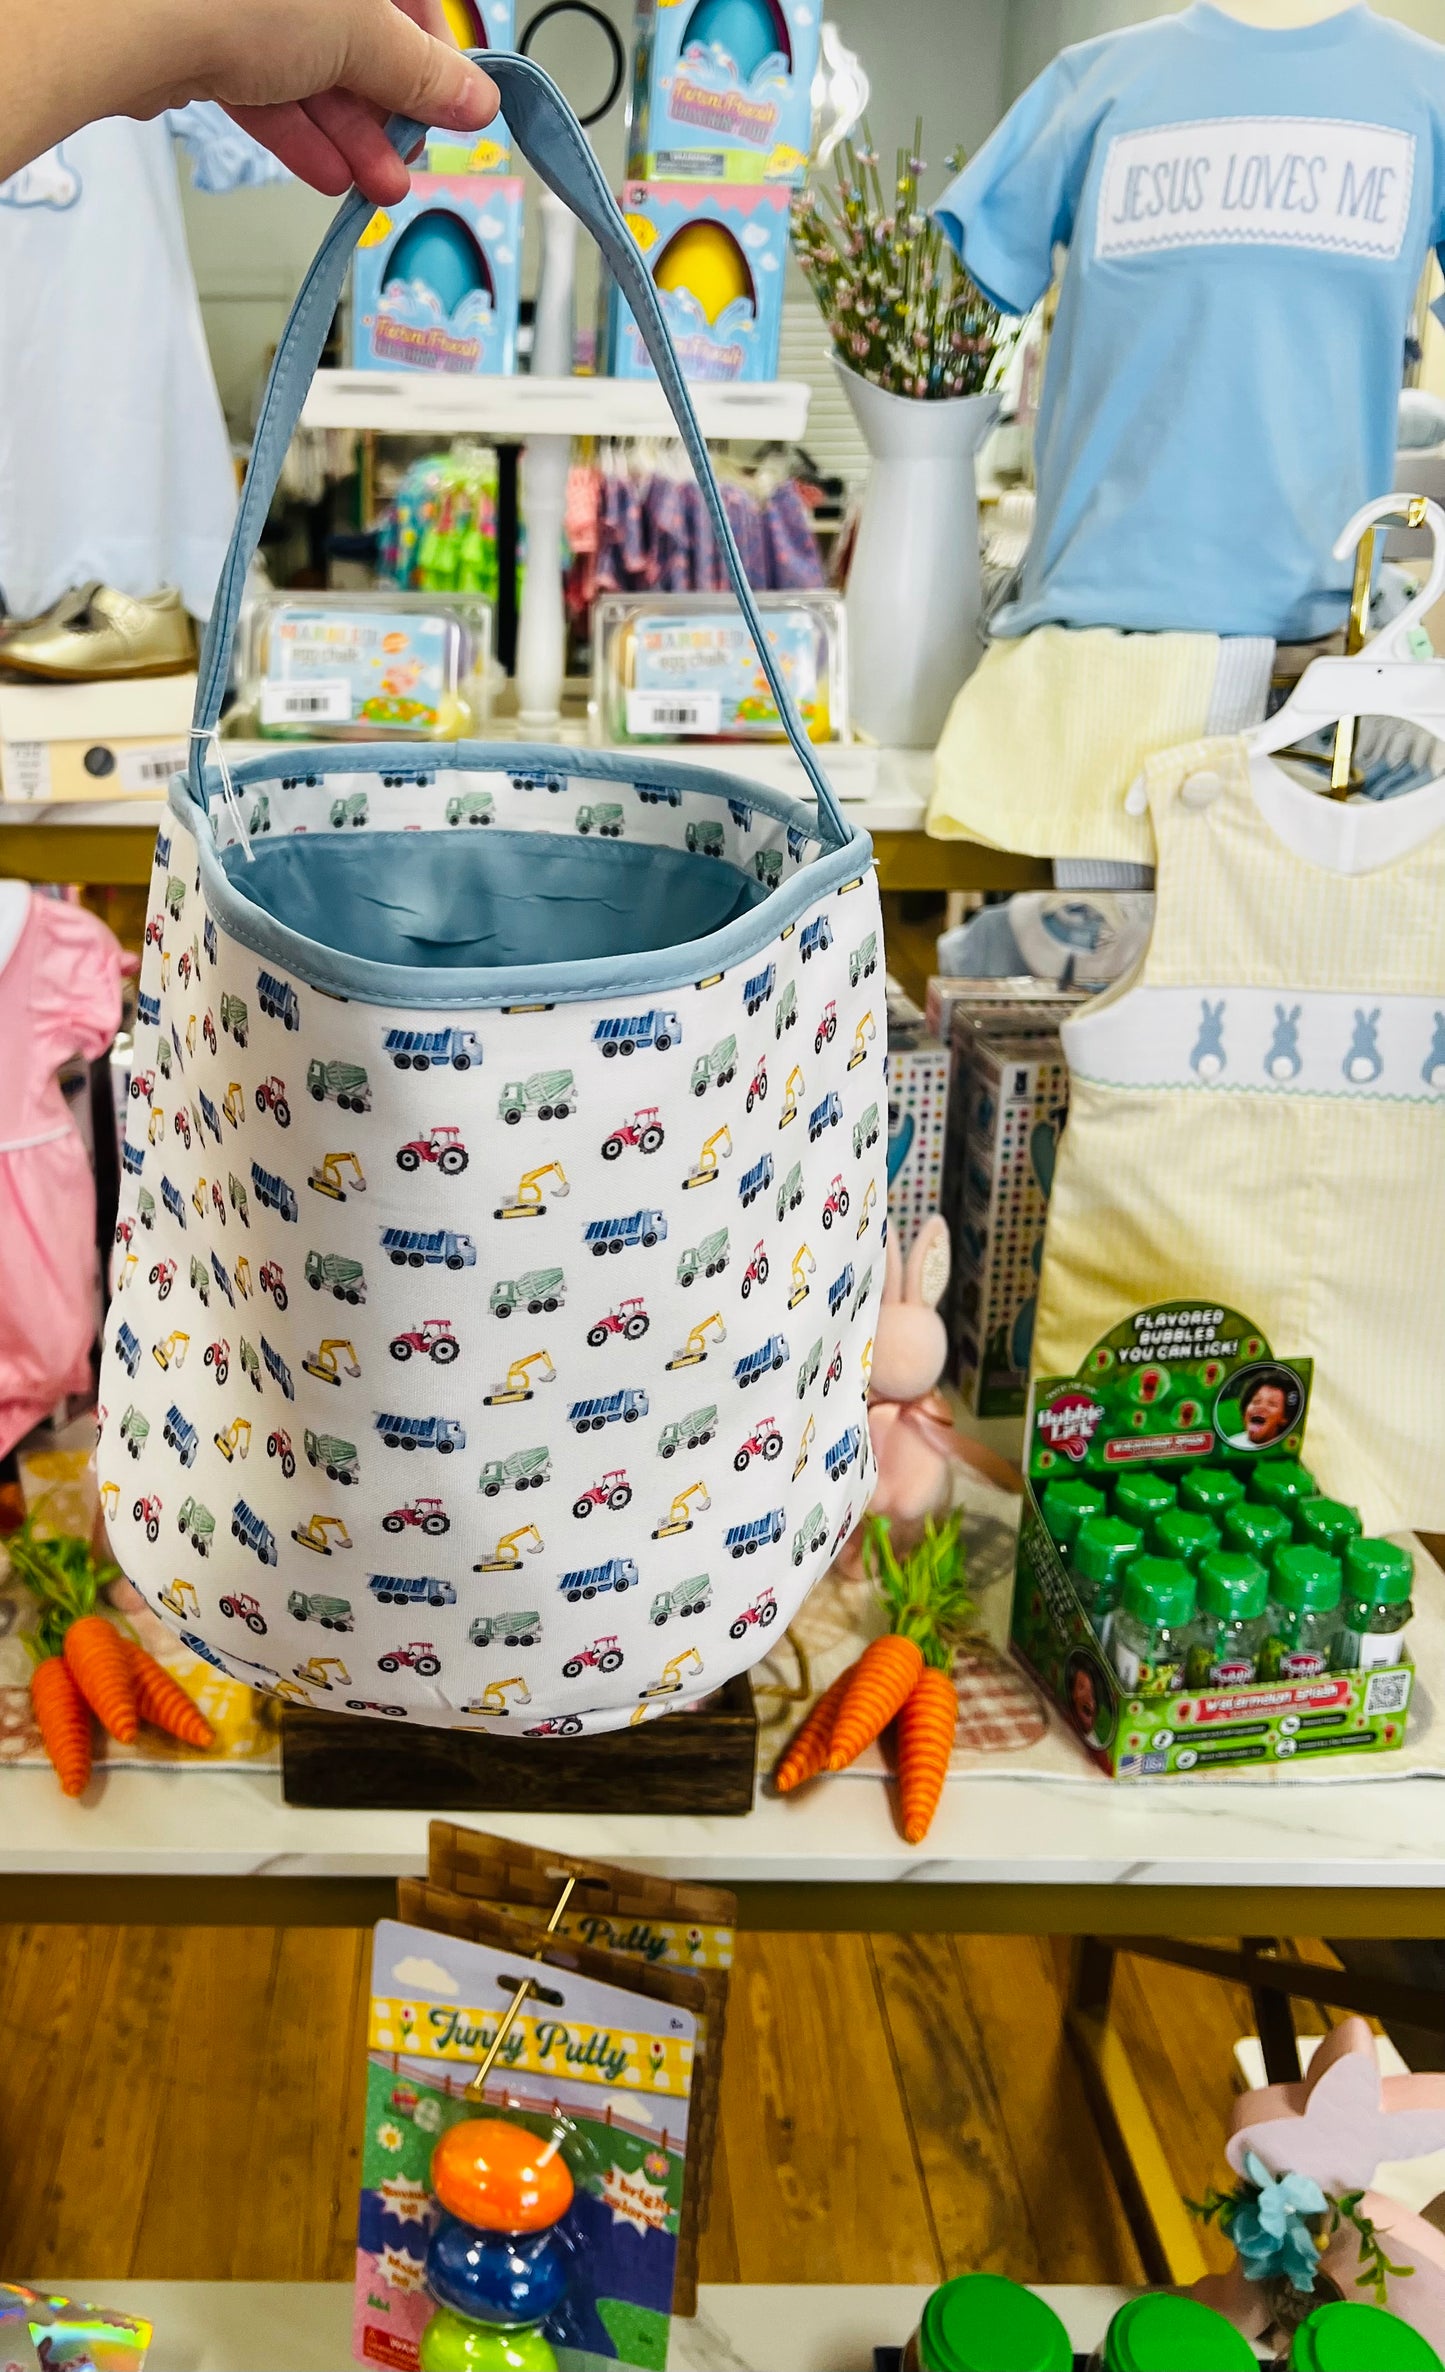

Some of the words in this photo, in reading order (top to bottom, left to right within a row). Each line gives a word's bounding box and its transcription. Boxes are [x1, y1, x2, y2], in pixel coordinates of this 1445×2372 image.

[1112, 156, 1211, 224] JESUS
[1221, 153, 1326, 215] LOVES
[1337, 160, 1396, 224] ME
[1134, 1309, 1224, 1330] FLAVORED
[1139, 1325, 1216, 1346] BUBBLES
[1119, 1346, 1154, 1363] YOU
[1156, 1343, 1192, 1361] CAN
[1194, 1339, 1238, 1358] LICK!
[577, 1917, 669, 1961] Putty
[536, 2020, 628, 2081] Putty
